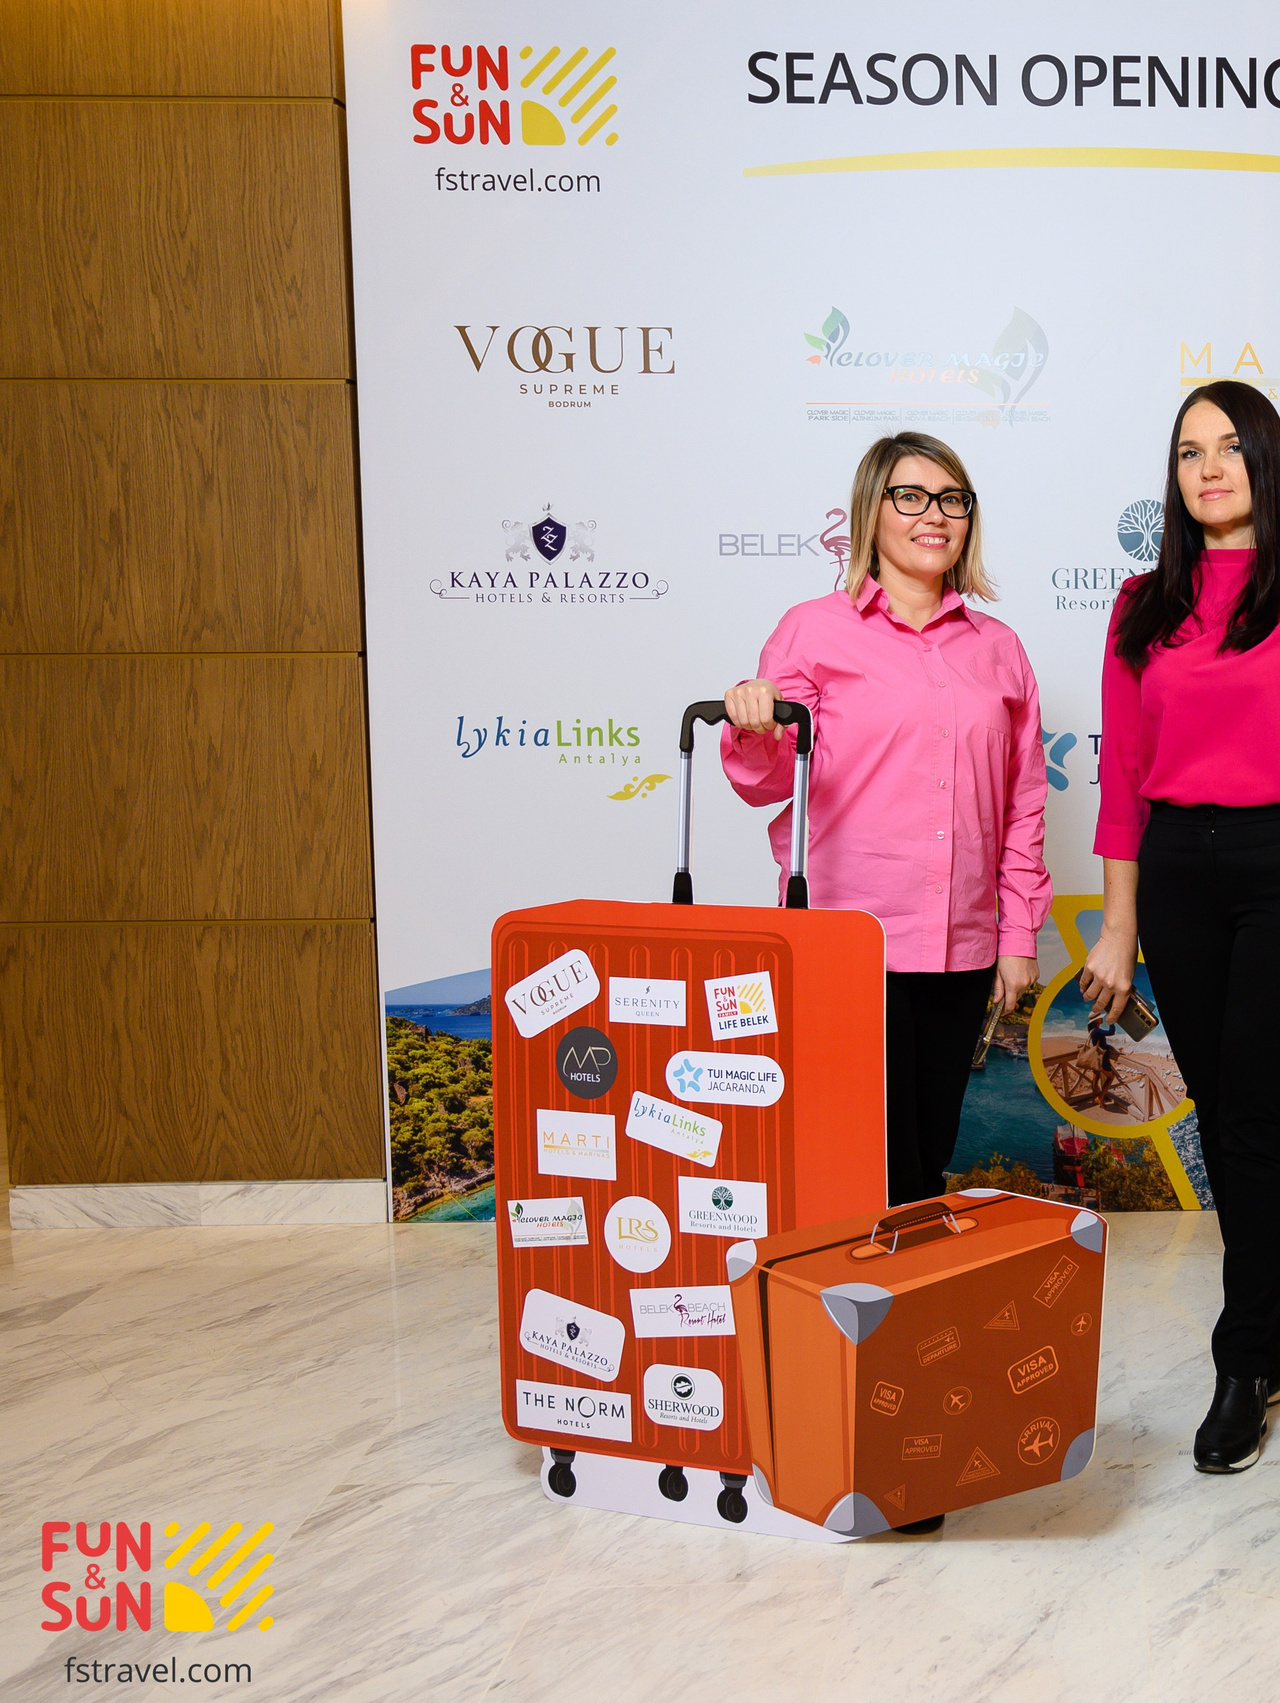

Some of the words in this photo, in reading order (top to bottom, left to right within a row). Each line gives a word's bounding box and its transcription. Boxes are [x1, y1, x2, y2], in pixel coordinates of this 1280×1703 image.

[411, 44, 508, 91] FUN
[747, 51, 998, 106] SEASON
[451, 83, 469, 106] &
[413, 99, 510, 145] SUN
[435, 167, 600, 192] fstravel.com
[454, 325, 675, 374] VOGUE
[837, 352, 934, 367] CLOVER
[520, 384, 619, 395] SUPREME
[1268, 389, 1279, 399] &
[719, 534, 820, 556] BELEK
[450, 572, 518, 588] KAYA
[528, 572, 649, 589] PALAZZO
[476, 593, 532, 603] HOTELS
[541, 592, 552, 603] &
[561, 593, 624, 603] RESORTS
[559, 753, 640, 766] Antalya
[512, 960, 588, 1015] VOGUE
[714, 986, 735, 999] FUN
[541, 993, 574, 1015] SUPREME
[615, 997, 680, 1009] SERENITY
[716, 999, 737, 1012] SUN
[719, 1020, 737, 1030] LIFE
[740, 1016, 769, 1027] BELEK
[571, 1072, 600, 1082] HOTELS
[707, 1069, 722, 1078] TUI
[726, 1070, 755, 1080] MAGIC
[758, 1072, 777, 1082] LIFE
[708, 1082, 765, 1094] JACARANDA
[543, 1131, 610, 1148] MARTI
[689, 1210, 757, 1224] GREENWOOD
[691, 1221, 716, 1229] Resorts
[616, 1217, 659, 1244] LRS
[1044, 1272, 1060, 1289] VISA
[1044, 1264, 1073, 1302] APPROVED
[640, 1305, 674, 1314] BELEK
[687, 1302, 726, 1312] BEACH
[532, 1331, 558, 1347] KAYA
[561, 1343, 608, 1366] PALAZZO
[540, 1344, 562, 1356] HOTELS
[572, 1356, 597, 1369] RESORTS
[923, 1343, 957, 1363] DEPARTURE
[1018, 1356, 1046, 1376] VISA
[1017, 1364, 1053, 1388] APPROVED
[880, 1388, 896, 1401] VISA
[523, 1392, 555, 1409] THE
[566, 1396, 625, 1418] NORM
[648, 1399, 719, 1417] SHERWOOD
[874, 1398, 896, 1410] APPROVED
[557, 1419, 590, 1429] HOTELS
[1021, 1420, 1054, 1444] ARRIVAL
[905, 1445, 938, 1454] APPROVED
